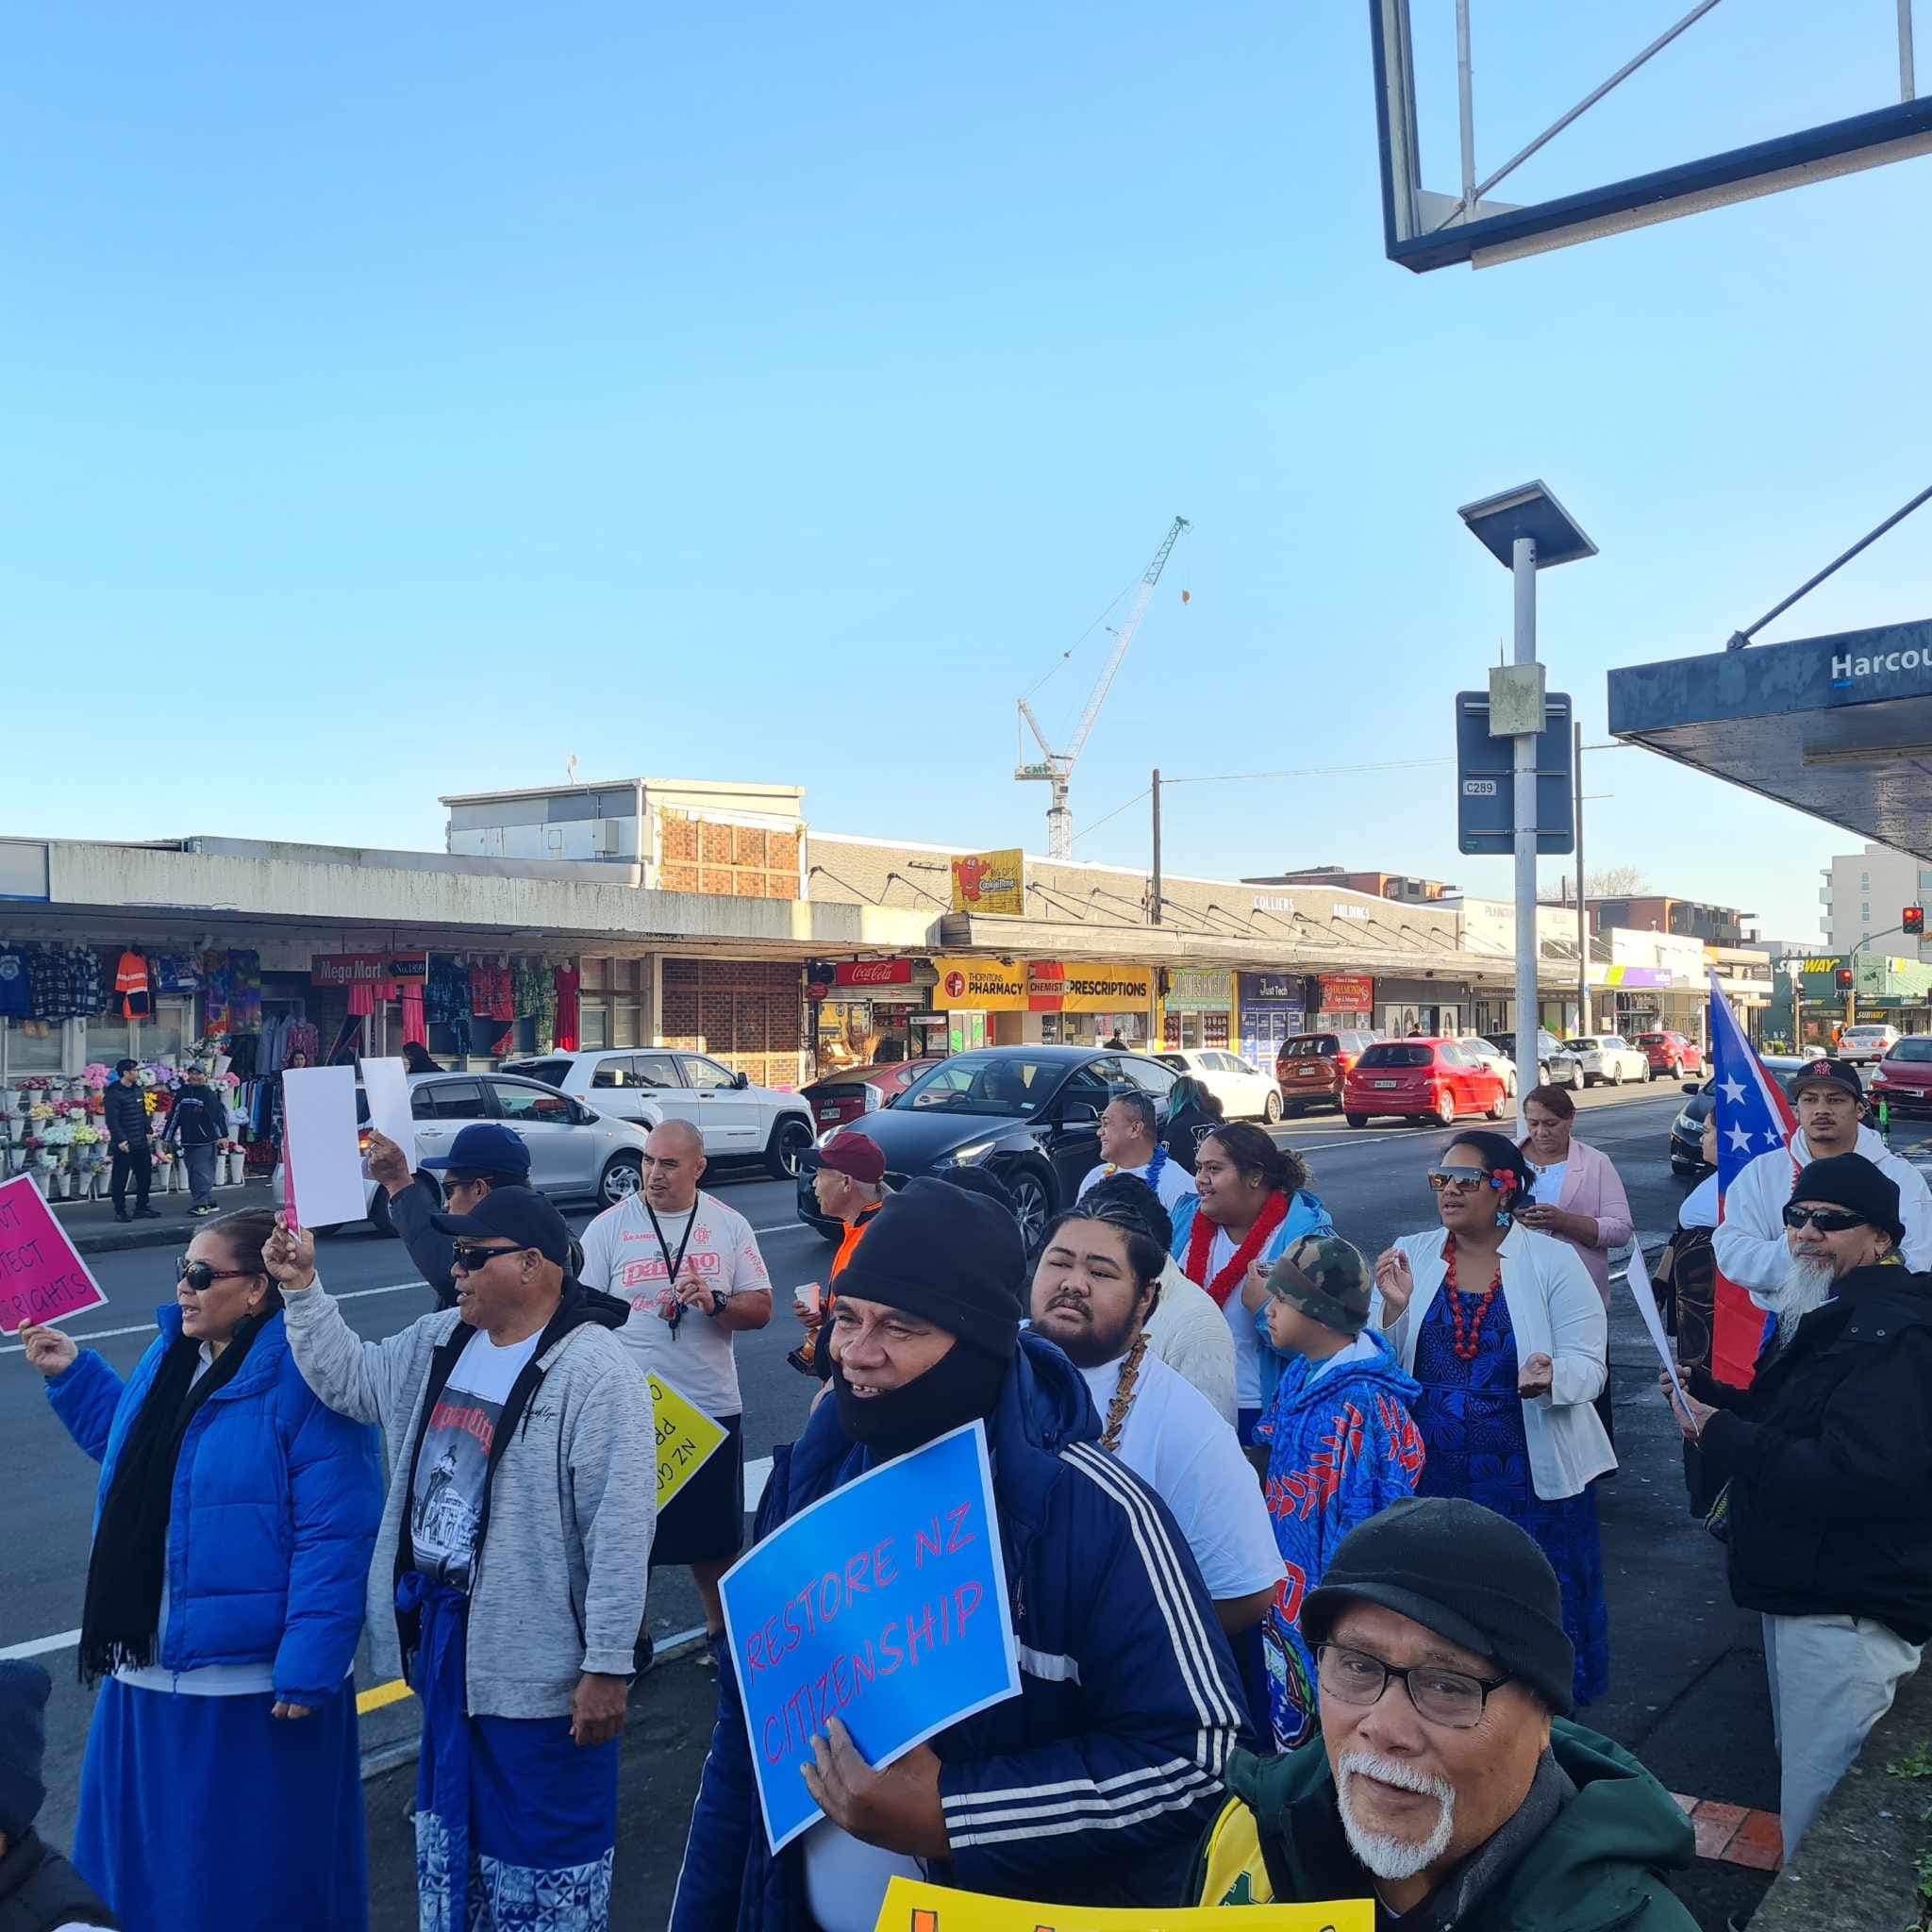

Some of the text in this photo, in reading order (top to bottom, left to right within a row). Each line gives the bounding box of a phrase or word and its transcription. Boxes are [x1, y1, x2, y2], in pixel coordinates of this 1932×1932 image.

[1466, 782, 1493, 793] C289
[1253, 895, 1294, 912] COLLIERS
[321, 960, 381, 983] Mega Mart
[851, 963, 893, 982] Coca-Cola
[968, 981, 1024, 996] PHARMACY
[1030, 981, 1063, 992] CHEMIST
[1069, 980, 1147, 997] PRESCRIPTIONS
[1274, 985, 1289, 996] Tech
[10, 1273, 88, 1314] RIGHTS
[671, 1437, 697, 1466] NZ
[746, 1501, 975, 1685] RESTORE NZ
[763, 1580, 983, 1765] CITIZENSHIP
